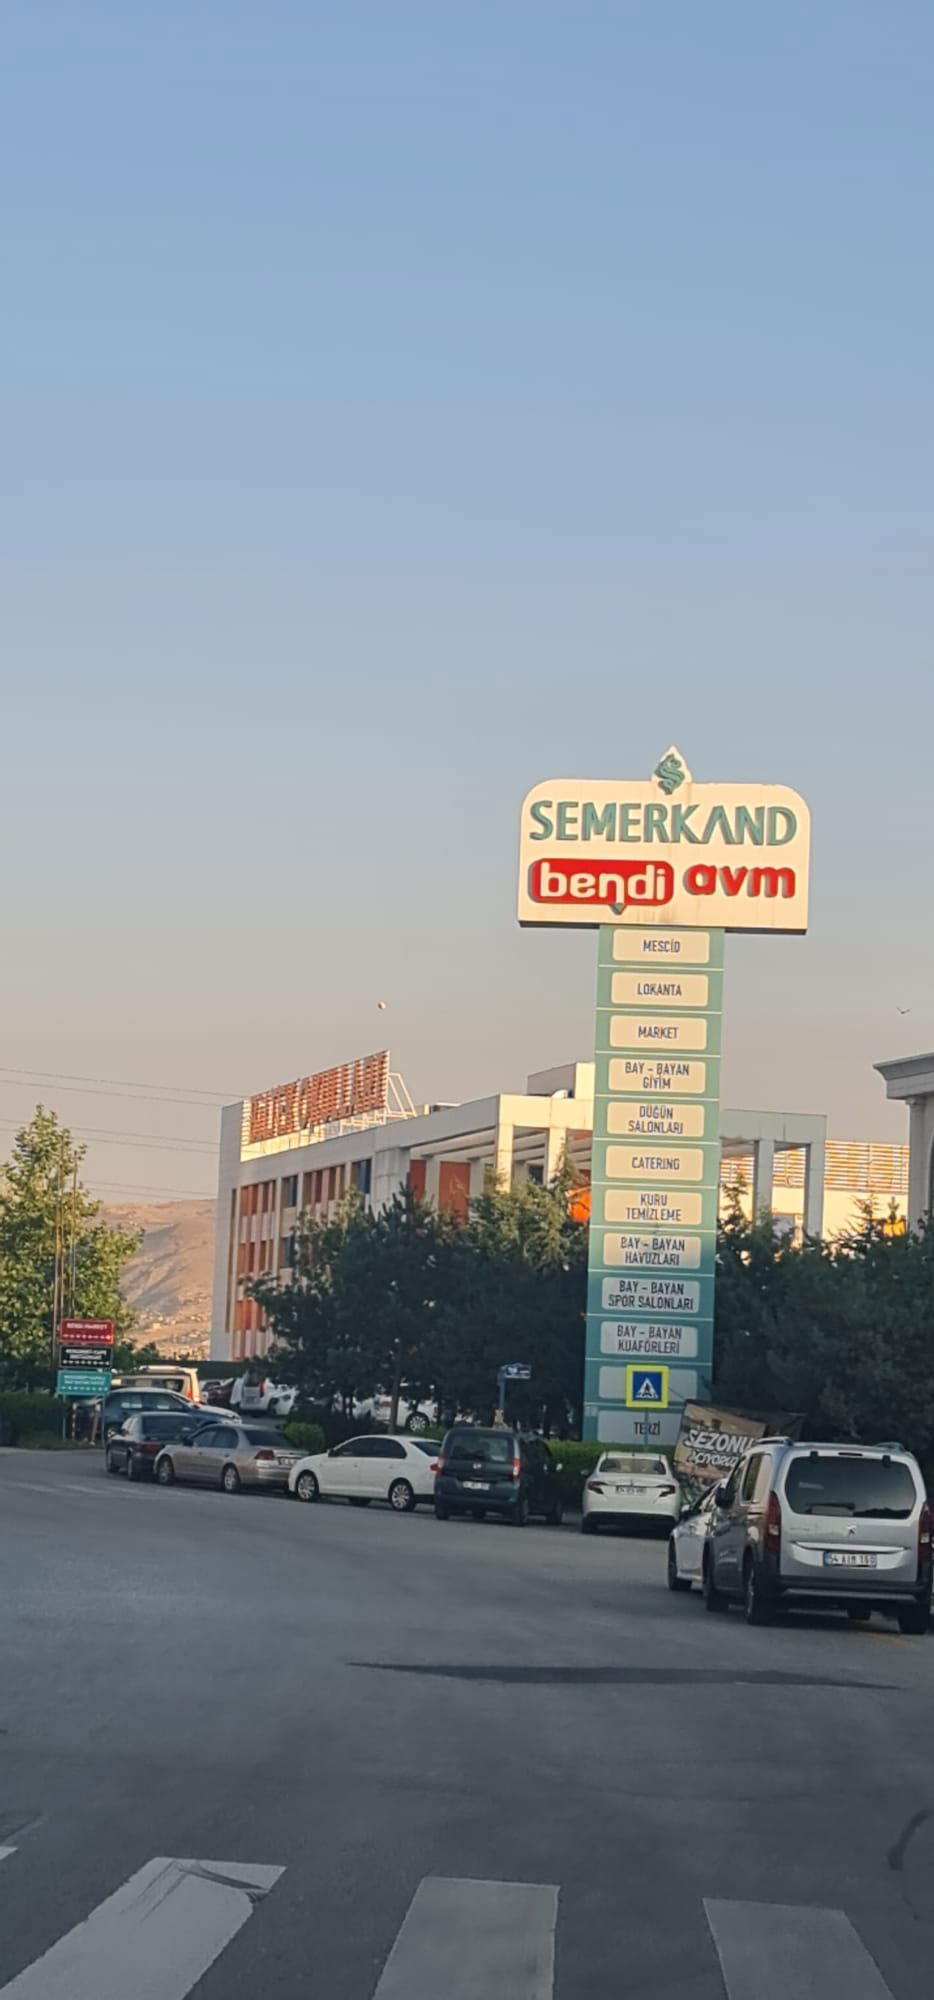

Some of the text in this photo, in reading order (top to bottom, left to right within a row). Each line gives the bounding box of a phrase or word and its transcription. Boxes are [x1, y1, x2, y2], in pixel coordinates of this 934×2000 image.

[529, 800, 797, 846] SEMERKAND
[540, 861, 796, 904] bendi avm
[643, 939, 680, 953] MESCİD
[637, 983, 682, 996] LOKANTA
[638, 1025, 678, 1039] MARKET
[625, 1062, 645, 1074] BAY
[657, 1063, 690, 1076] BAYAN
[643, 1075, 671, 1089] GİYİM
[640, 1104, 673, 1119] DÜĞÜN
[628, 1120, 684, 1134] SALONLARI
[632, 1157, 680, 1170] CATERING
[640, 1193, 668, 1206] KURU
[626, 1207, 682, 1221] TEMİZLEME
[621, 1237, 640, 1249] BAY
[652, 1238, 685, 1251] BAYAN
[625, 1251, 680, 1266] HAVUZLARI
[619, 1280, 639, 1293] BAY
[651, 1281, 684, 1295] BAYAN
[608, 1294, 694, 1310] SPOR SALONLARI
[617, 1325, 637, 1337] BAY
[649, 1326, 682, 1339] BAYAN
